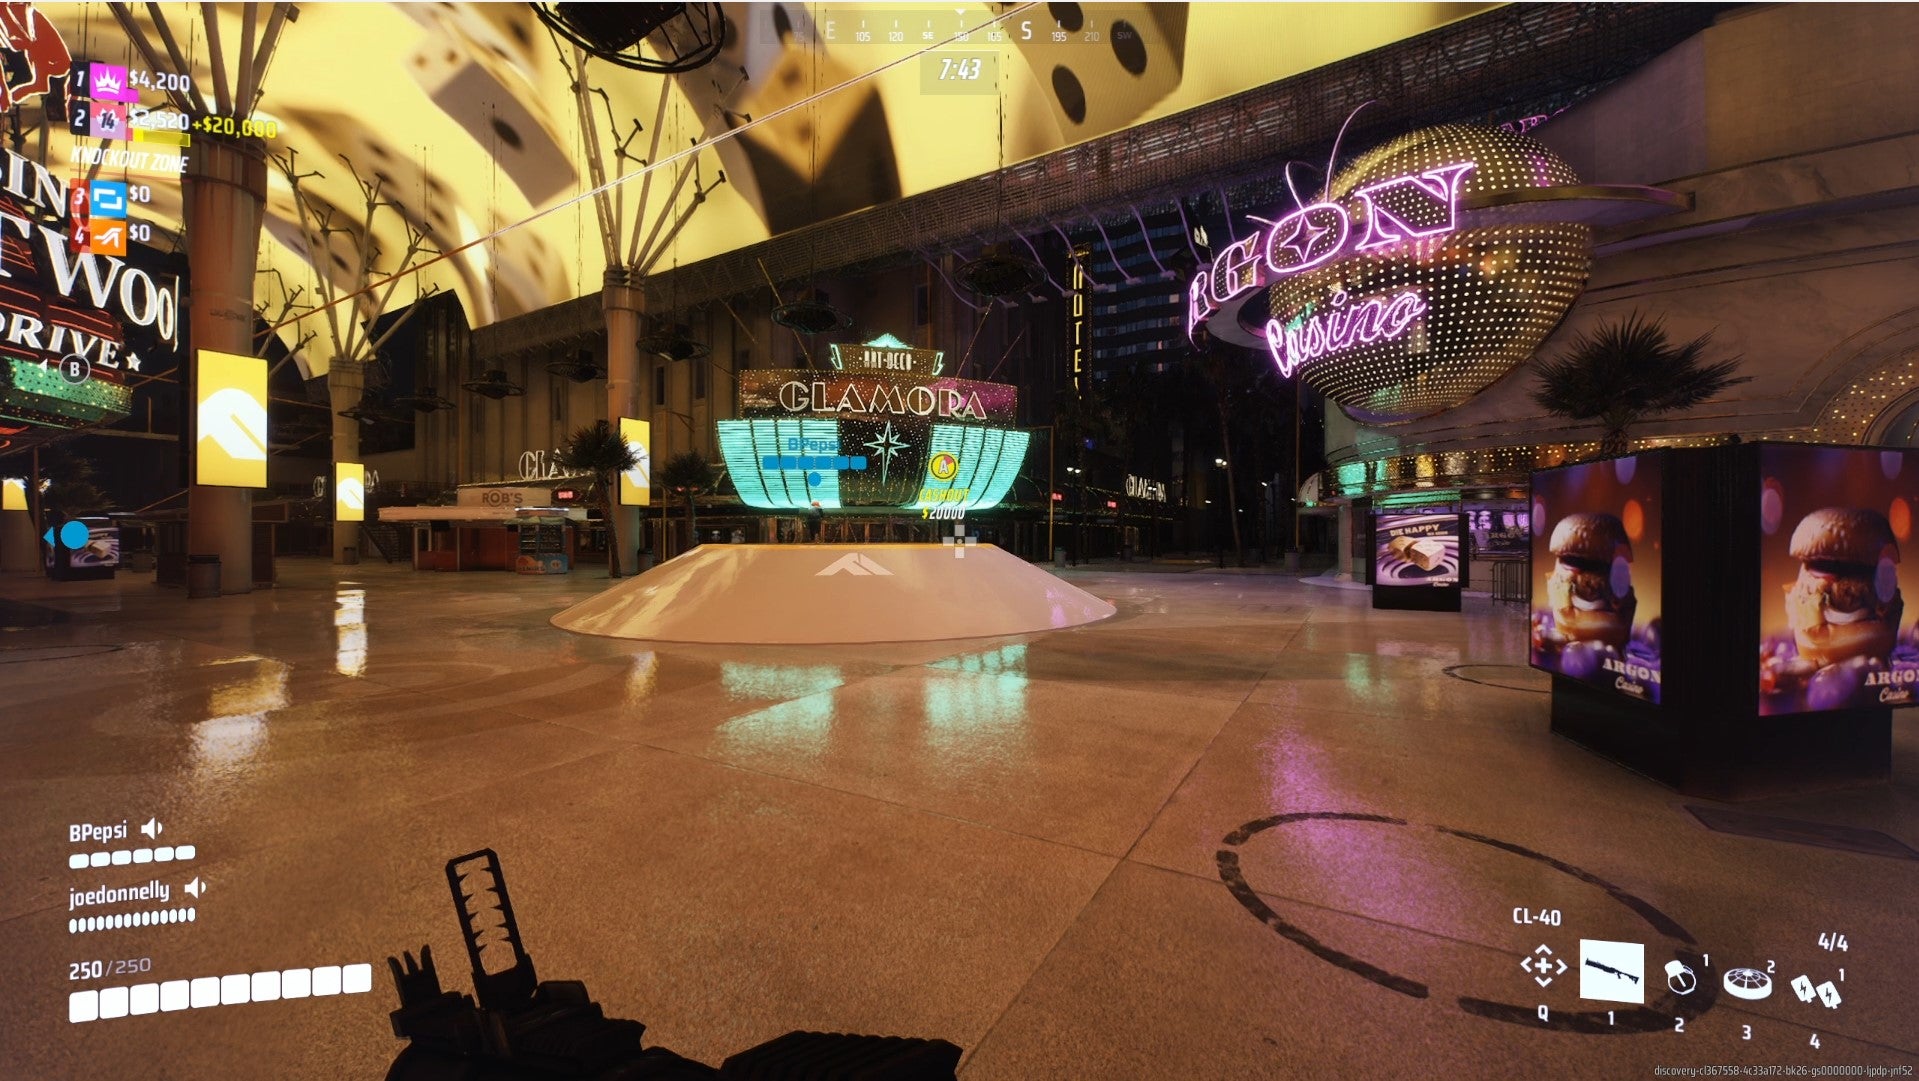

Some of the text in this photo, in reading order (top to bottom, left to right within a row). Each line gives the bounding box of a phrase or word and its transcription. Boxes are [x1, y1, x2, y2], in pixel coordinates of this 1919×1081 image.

[0, 311, 121, 369] RIVE
[1266, 290, 1427, 379] Casino
[779, 381, 988, 420] GLAMORA
[482, 491, 524, 505] ROB'S
[1389, 529, 1403, 537] DIE
[1404, 523, 1440, 534] HAPPY
[1602, 657, 1661, 684] ARGON
[1864, 669, 1919, 687] ARGO
